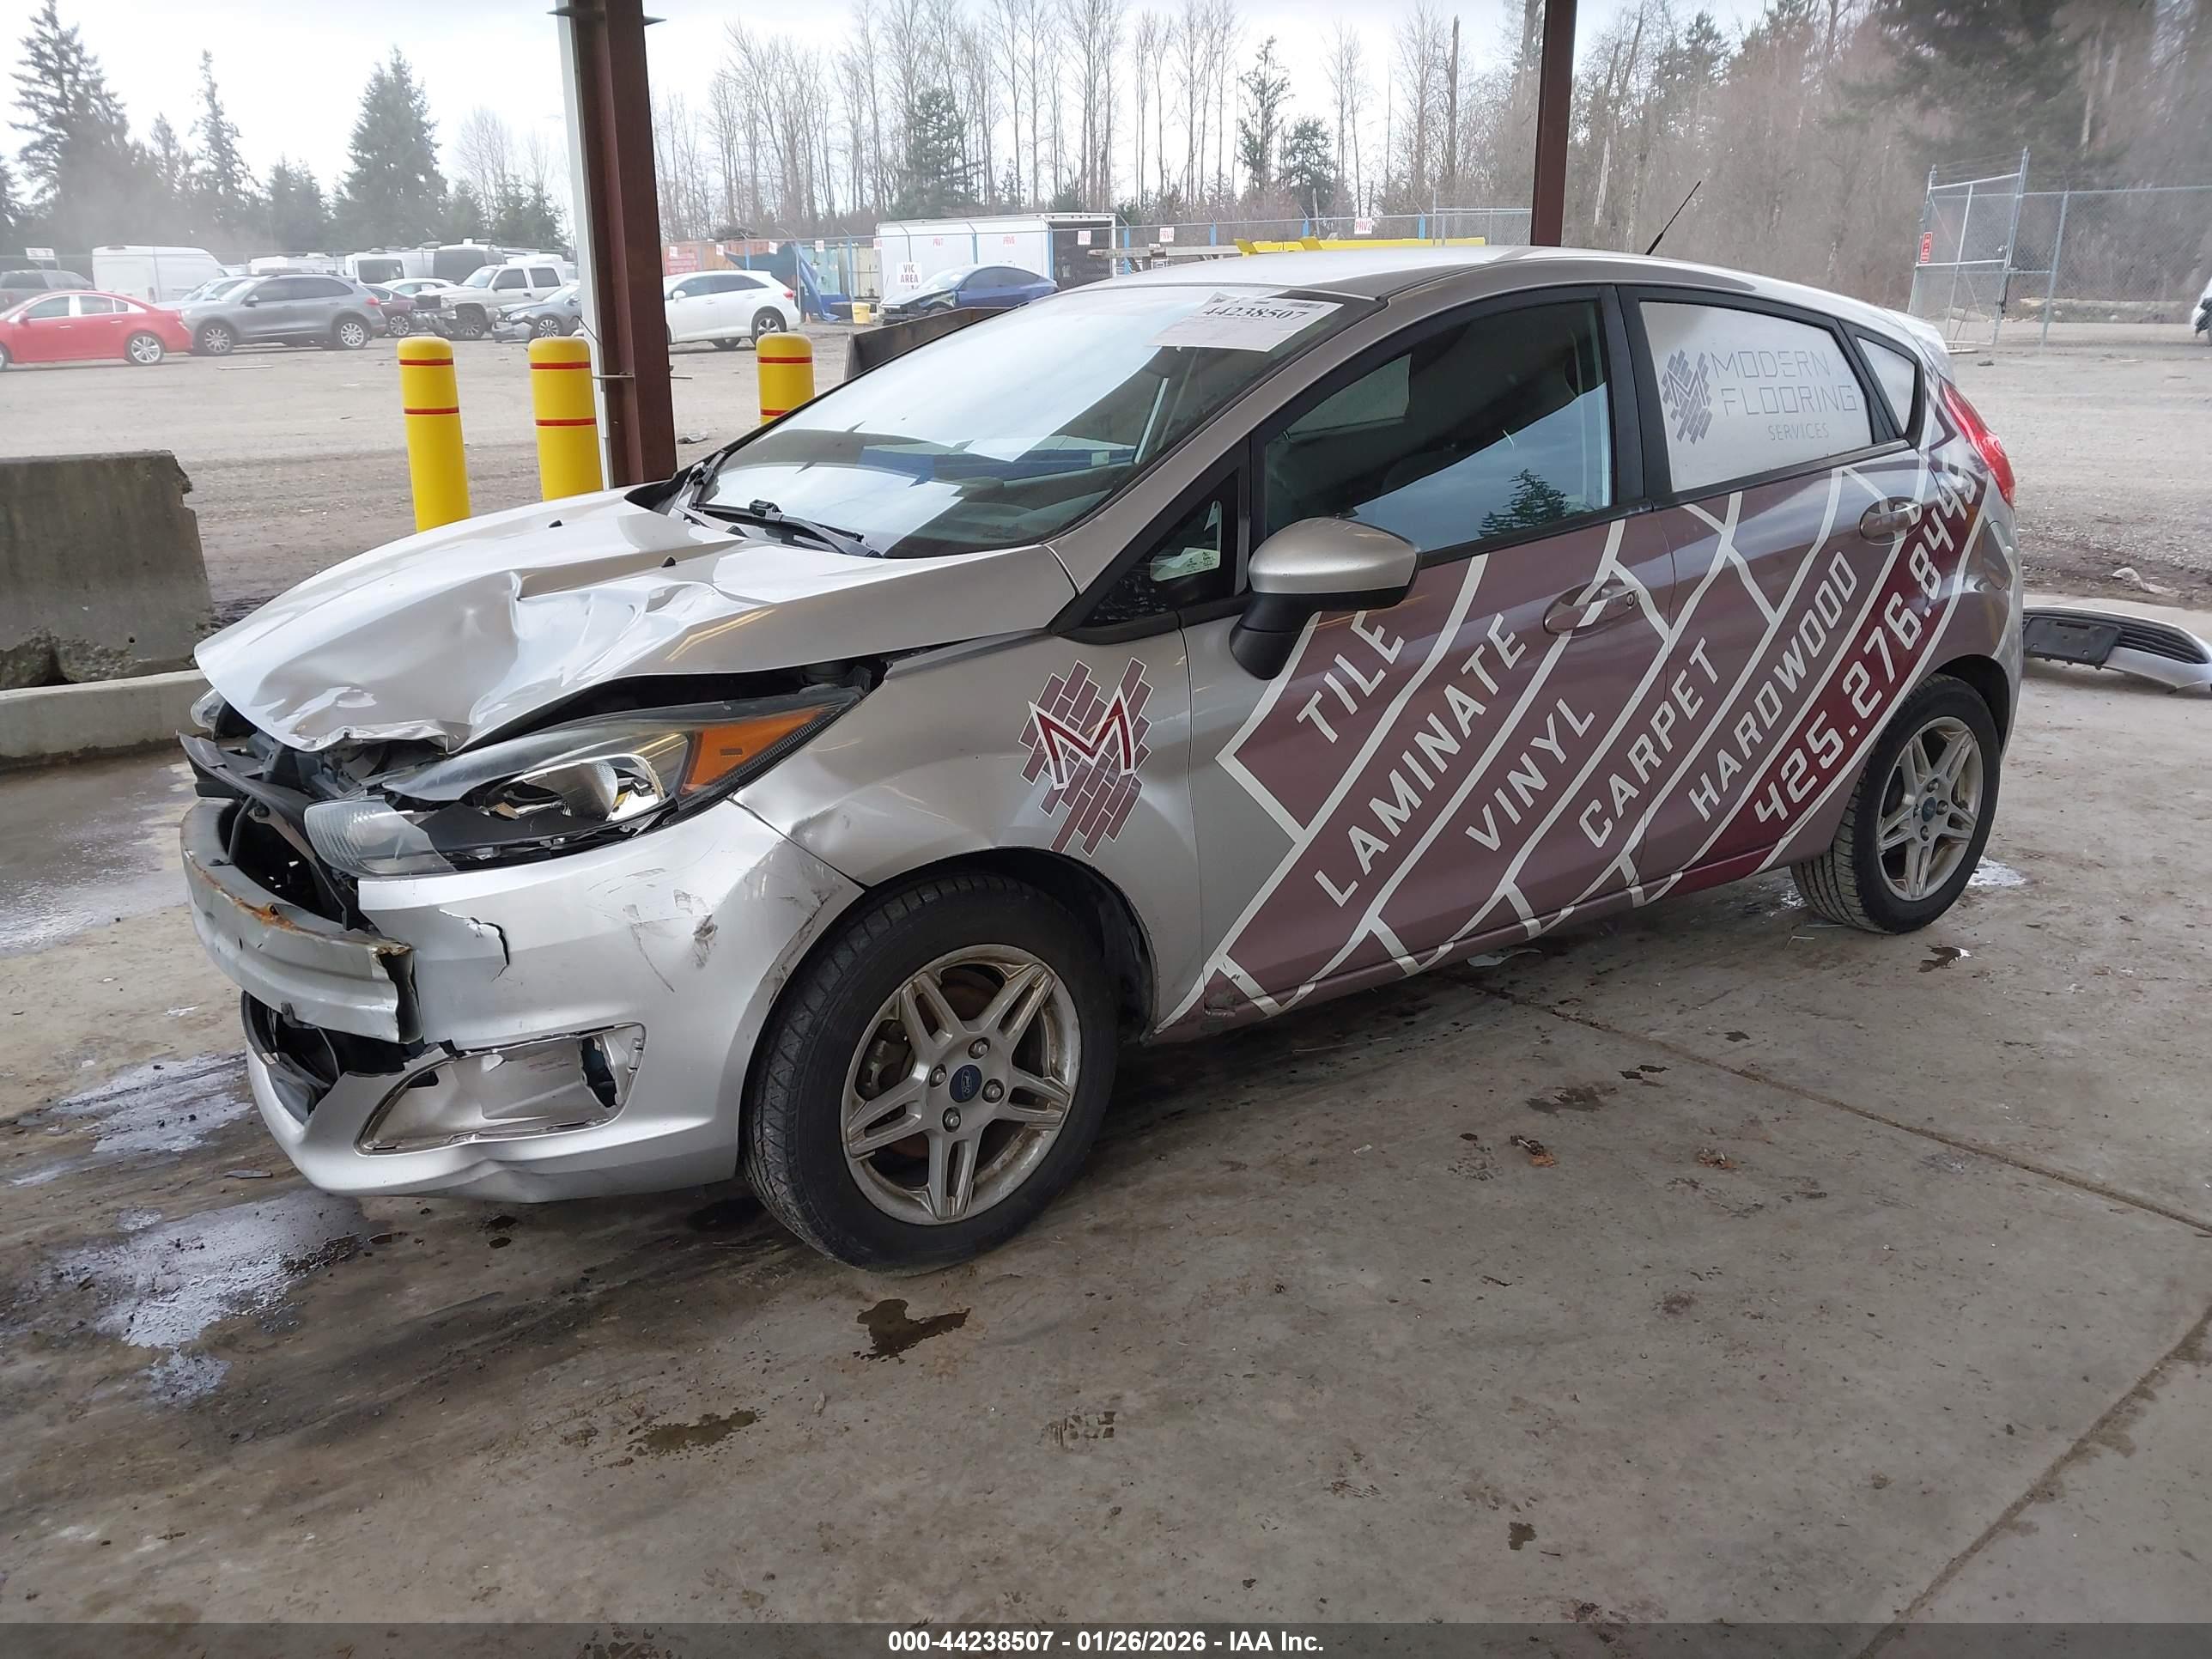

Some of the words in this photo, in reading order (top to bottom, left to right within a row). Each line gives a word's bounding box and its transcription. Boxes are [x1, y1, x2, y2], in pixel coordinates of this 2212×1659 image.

[1356, 220, 1372, 231] PRV2
[901, 274, 919, 283] AREA
[903, 264, 915, 273] VIC
[1203, 306, 1310, 320] 44238507
[1711, 350, 1831, 378] MODERN
[1721, 385, 1858, 416] FLOORING
[1768, 422, 1830, 441] SERVICES
[1296, 611, 1405, 744] TILE
[1688, 552, 1857, 821] HARDWOOD
[1028, 685, 1134, 790] M
[1579, 637, 1718, 848] CARPET
[1314, 612, 1527, 907] LAMINATE
[1465, 698, 1595, 852] VINYL
